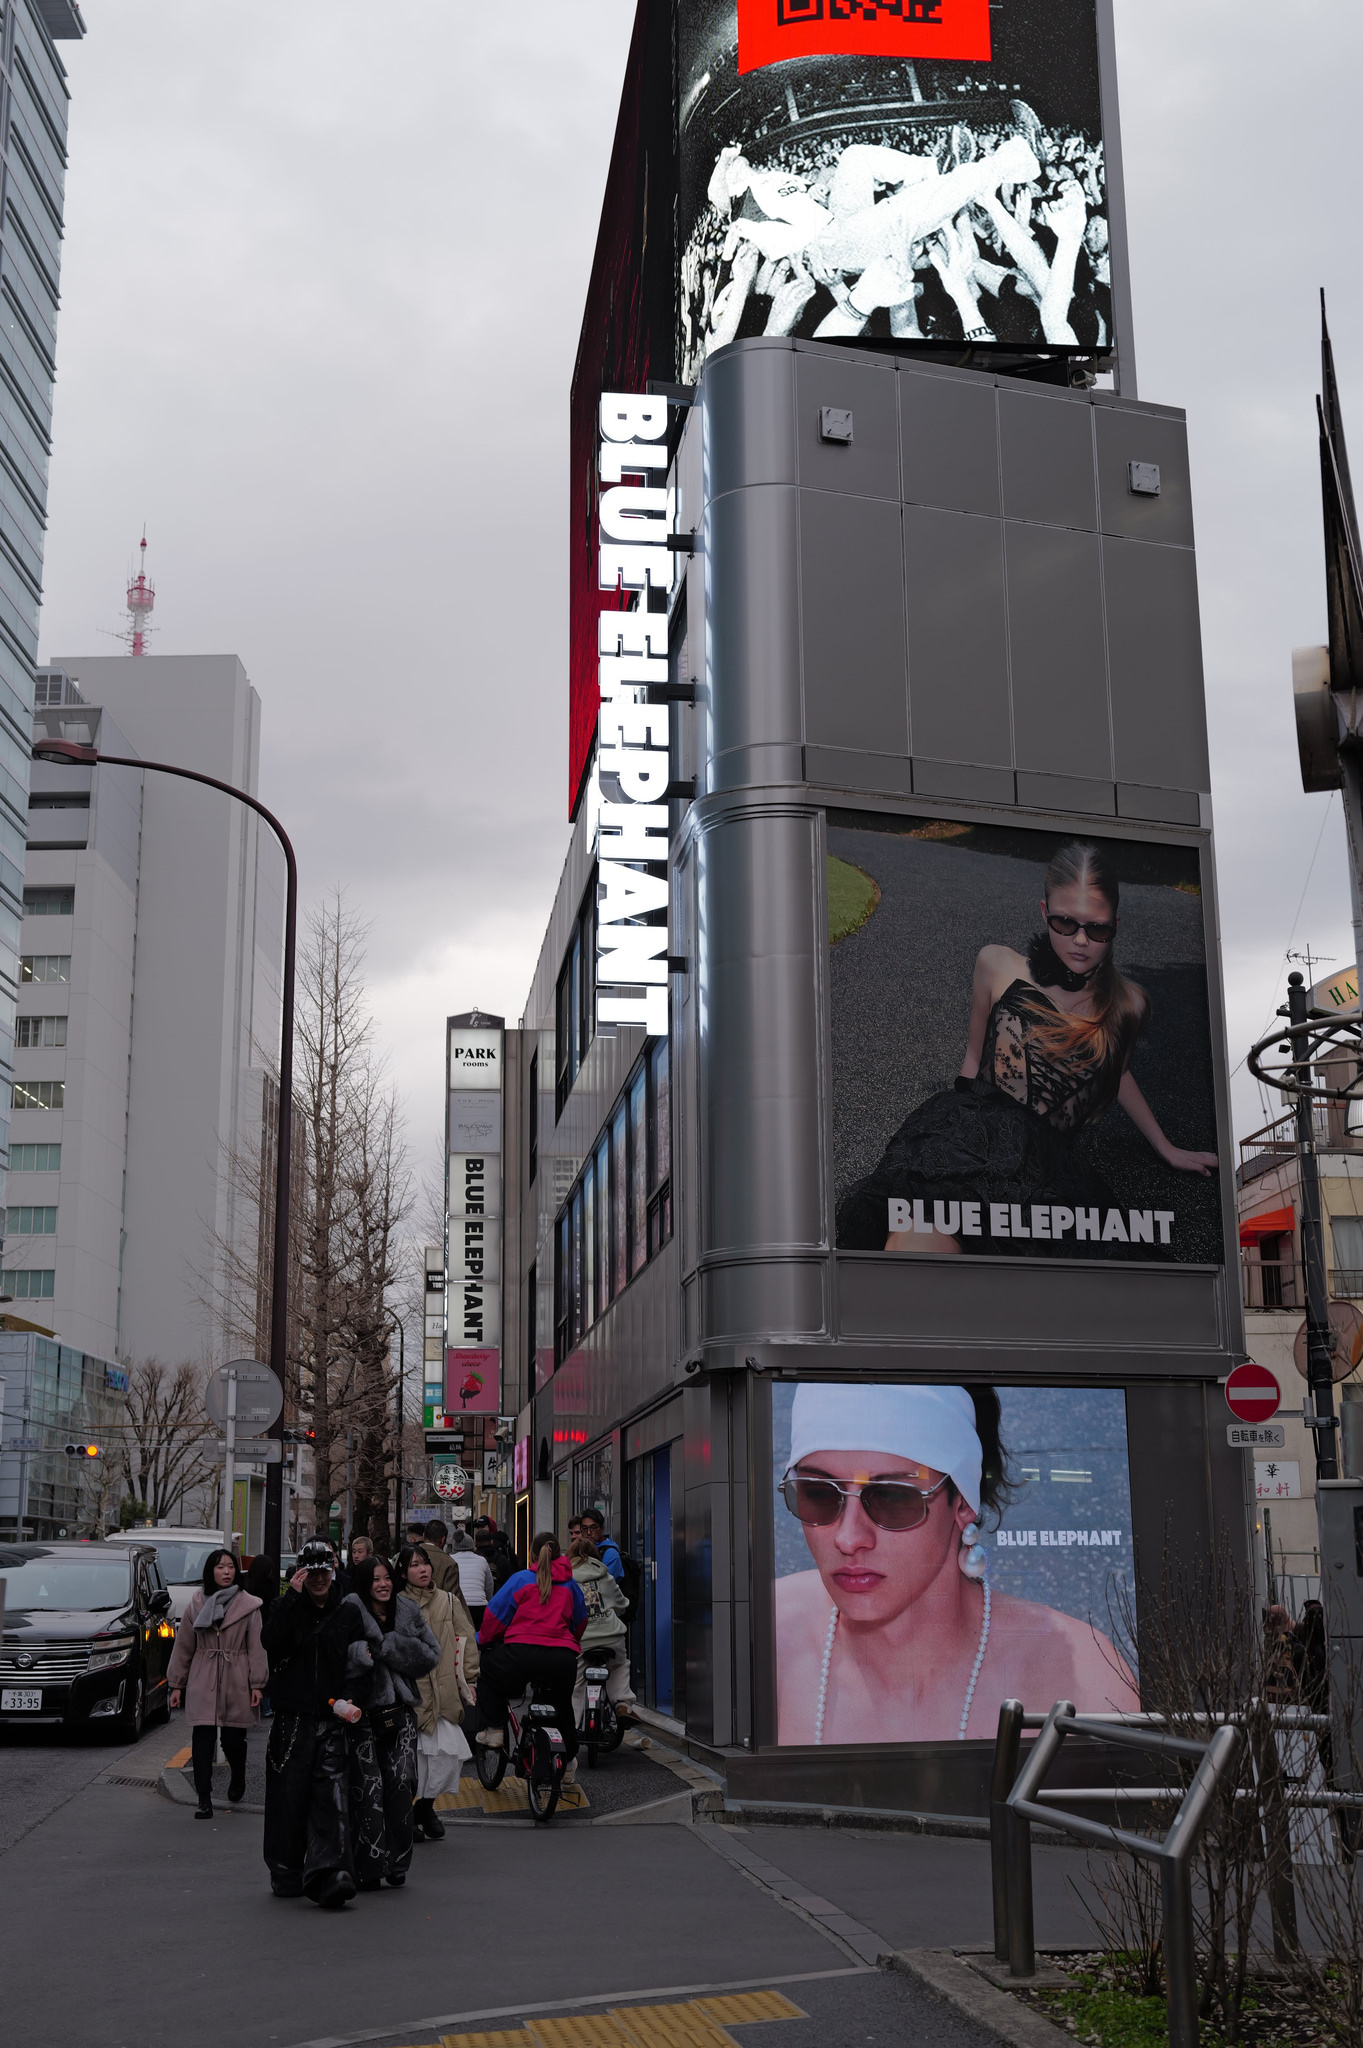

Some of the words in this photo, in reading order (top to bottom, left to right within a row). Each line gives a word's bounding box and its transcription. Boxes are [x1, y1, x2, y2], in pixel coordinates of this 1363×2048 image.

[599, 392, 670, 591] BLUE
[597, 611, 669, 1037] ELEPHANT
[1328, 977, 1359, 1007] HA
[455, 1047, 496, 1059] PARK
[465, 1158, 485, 1214] BLUE
[888, 1198, 982, 1236] BLUE
[989, 1202, 1175, 1244] ELEPHANT
[464, 1221, 484, 1342] ELEPHANT
[1231, 1429, 1280, 1443] 自転車を除く
[438, 1485, 465, 1498] ラーメン
[996, 1530, 1038, 1546] BLUE
[1040, 1530, 1122, 1546] ELEPHANT
[10, 1697, 40, 1709] 33-95
